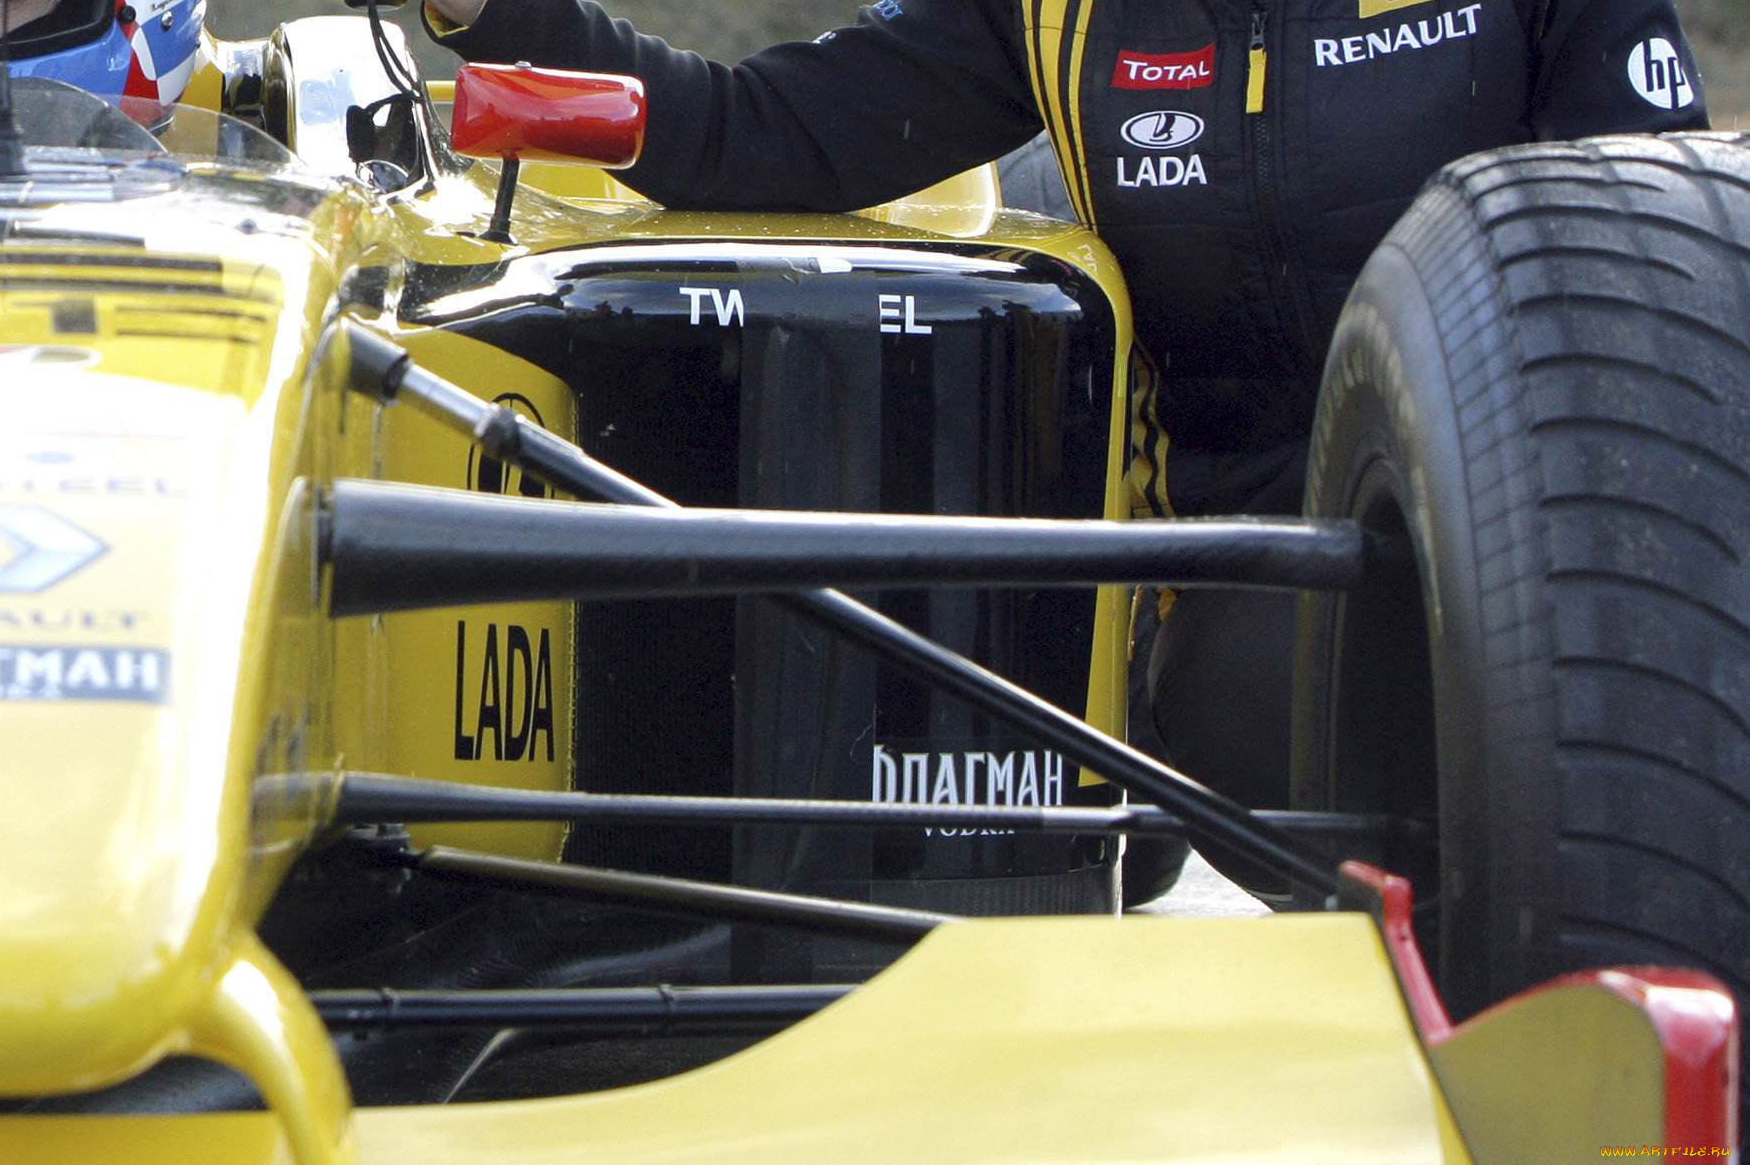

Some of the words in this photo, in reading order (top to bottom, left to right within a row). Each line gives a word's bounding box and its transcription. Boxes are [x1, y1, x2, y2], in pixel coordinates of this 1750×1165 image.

[1314, 3, 1482, 66] RENAULT
[1123, 59, 1210, 81] TOTAL
[1642, 37, 1686, 108] hp
[1116, 154, 1208, 187] LADA
[679, 287, 744, 327] TW
[454, 620, 555, 762] LADA
